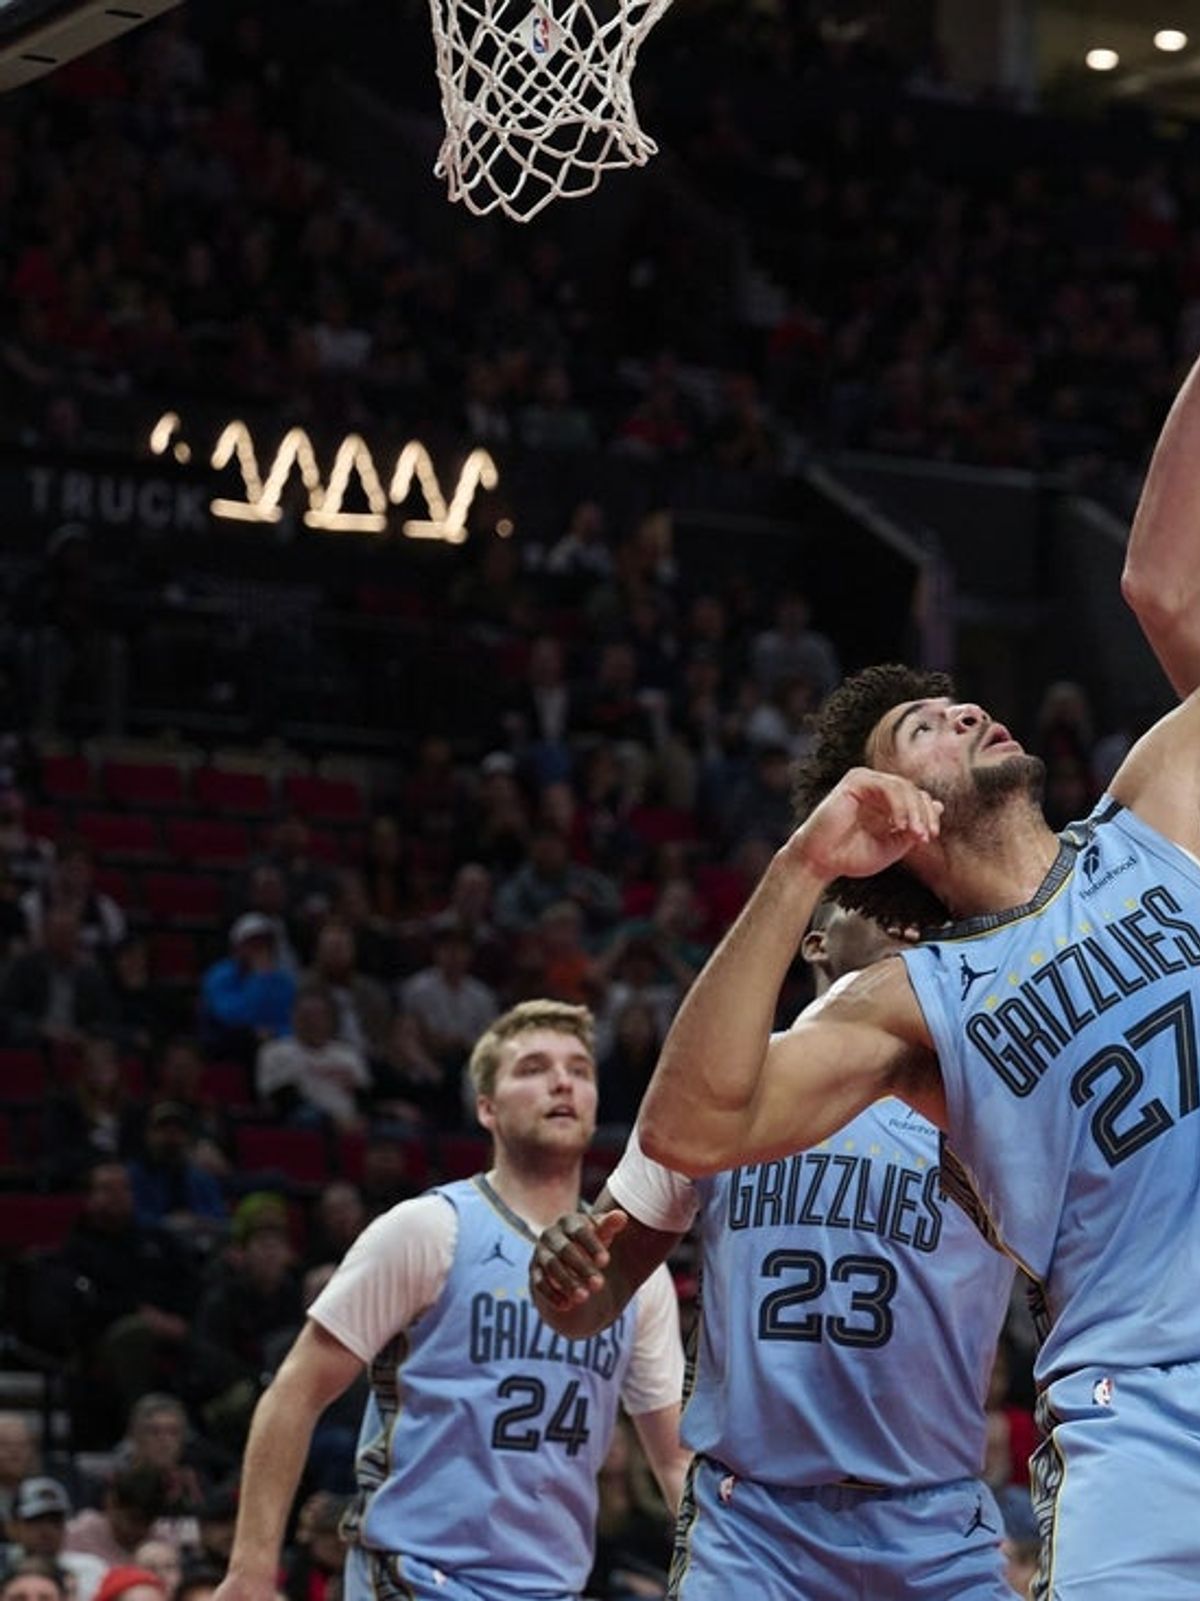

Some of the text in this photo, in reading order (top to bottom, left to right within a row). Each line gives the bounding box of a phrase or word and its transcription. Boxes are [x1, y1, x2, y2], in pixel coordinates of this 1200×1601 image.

[26, 467, 208, 531] TRUCK
[1070, 990, 1200, 1168] 27
[728, 1154, 947, 1253] GRIZZLIES
[758, 1248, 897, 1349] 23
[491, 1374, 590, 1457] 24
